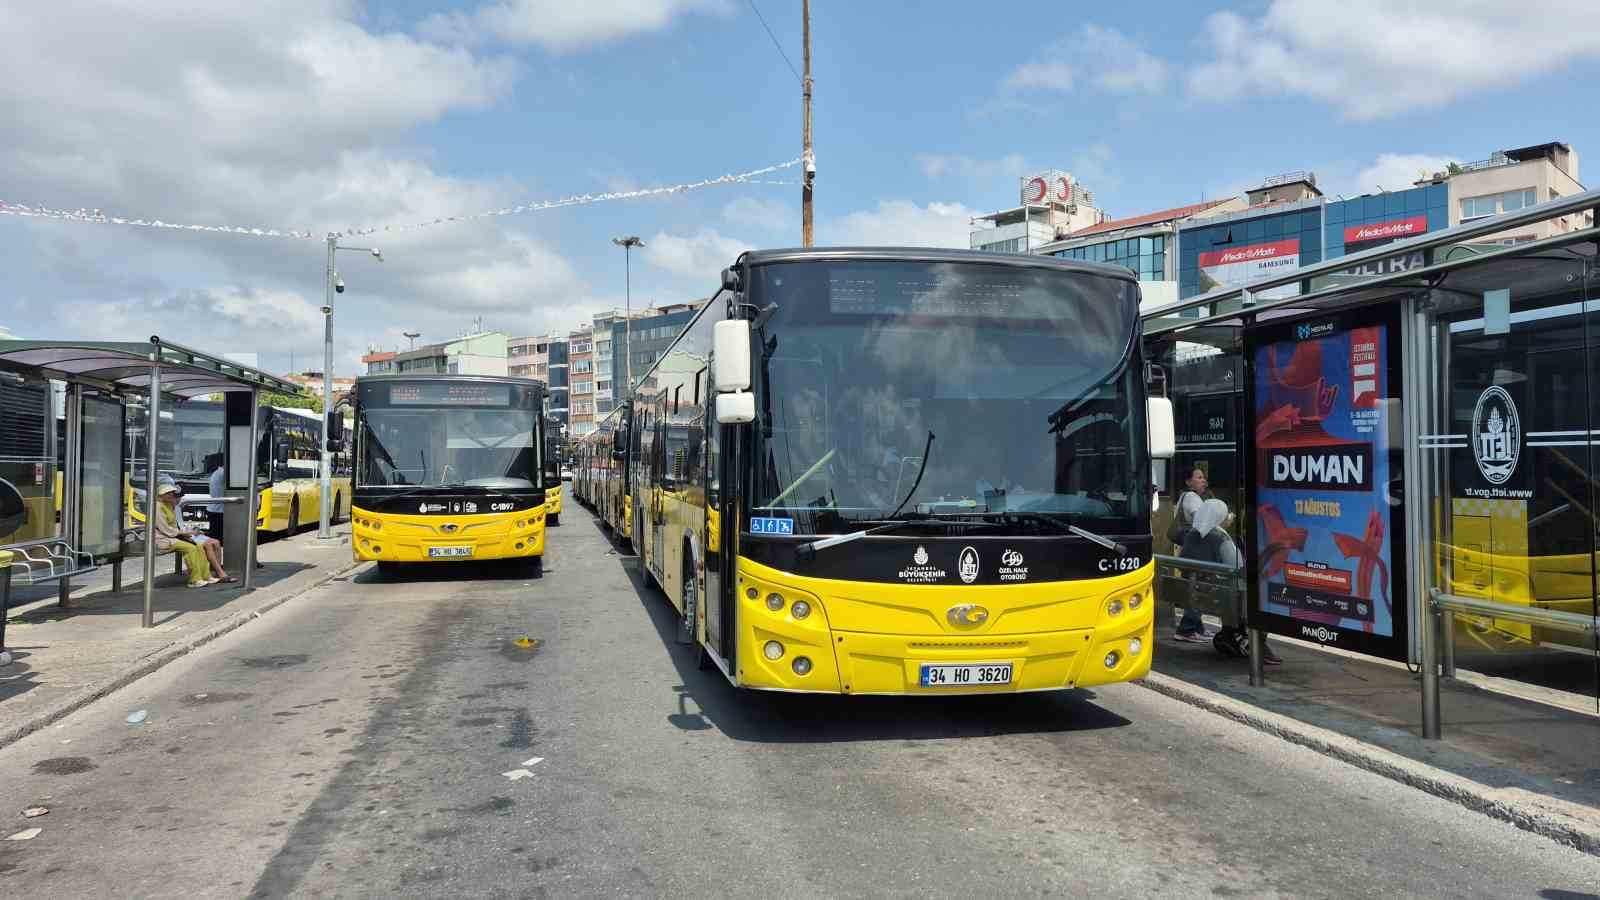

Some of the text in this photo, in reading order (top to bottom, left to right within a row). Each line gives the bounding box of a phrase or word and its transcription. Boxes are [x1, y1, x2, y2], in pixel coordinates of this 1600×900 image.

[1258, 257, 1294, 269] SAMSUNG
[1273, 454, 1363, 484] DUMAN
[999, 566, 1012, 574] ÖZEL
[1099, 557, 1140, 571] C-1620
[898, 570, 946, 579] BÜYÜKŞEHİR
[1302, 626, 1338, 641] PANOUT
[930, 667, 1009, 683] 34 HO 3620
